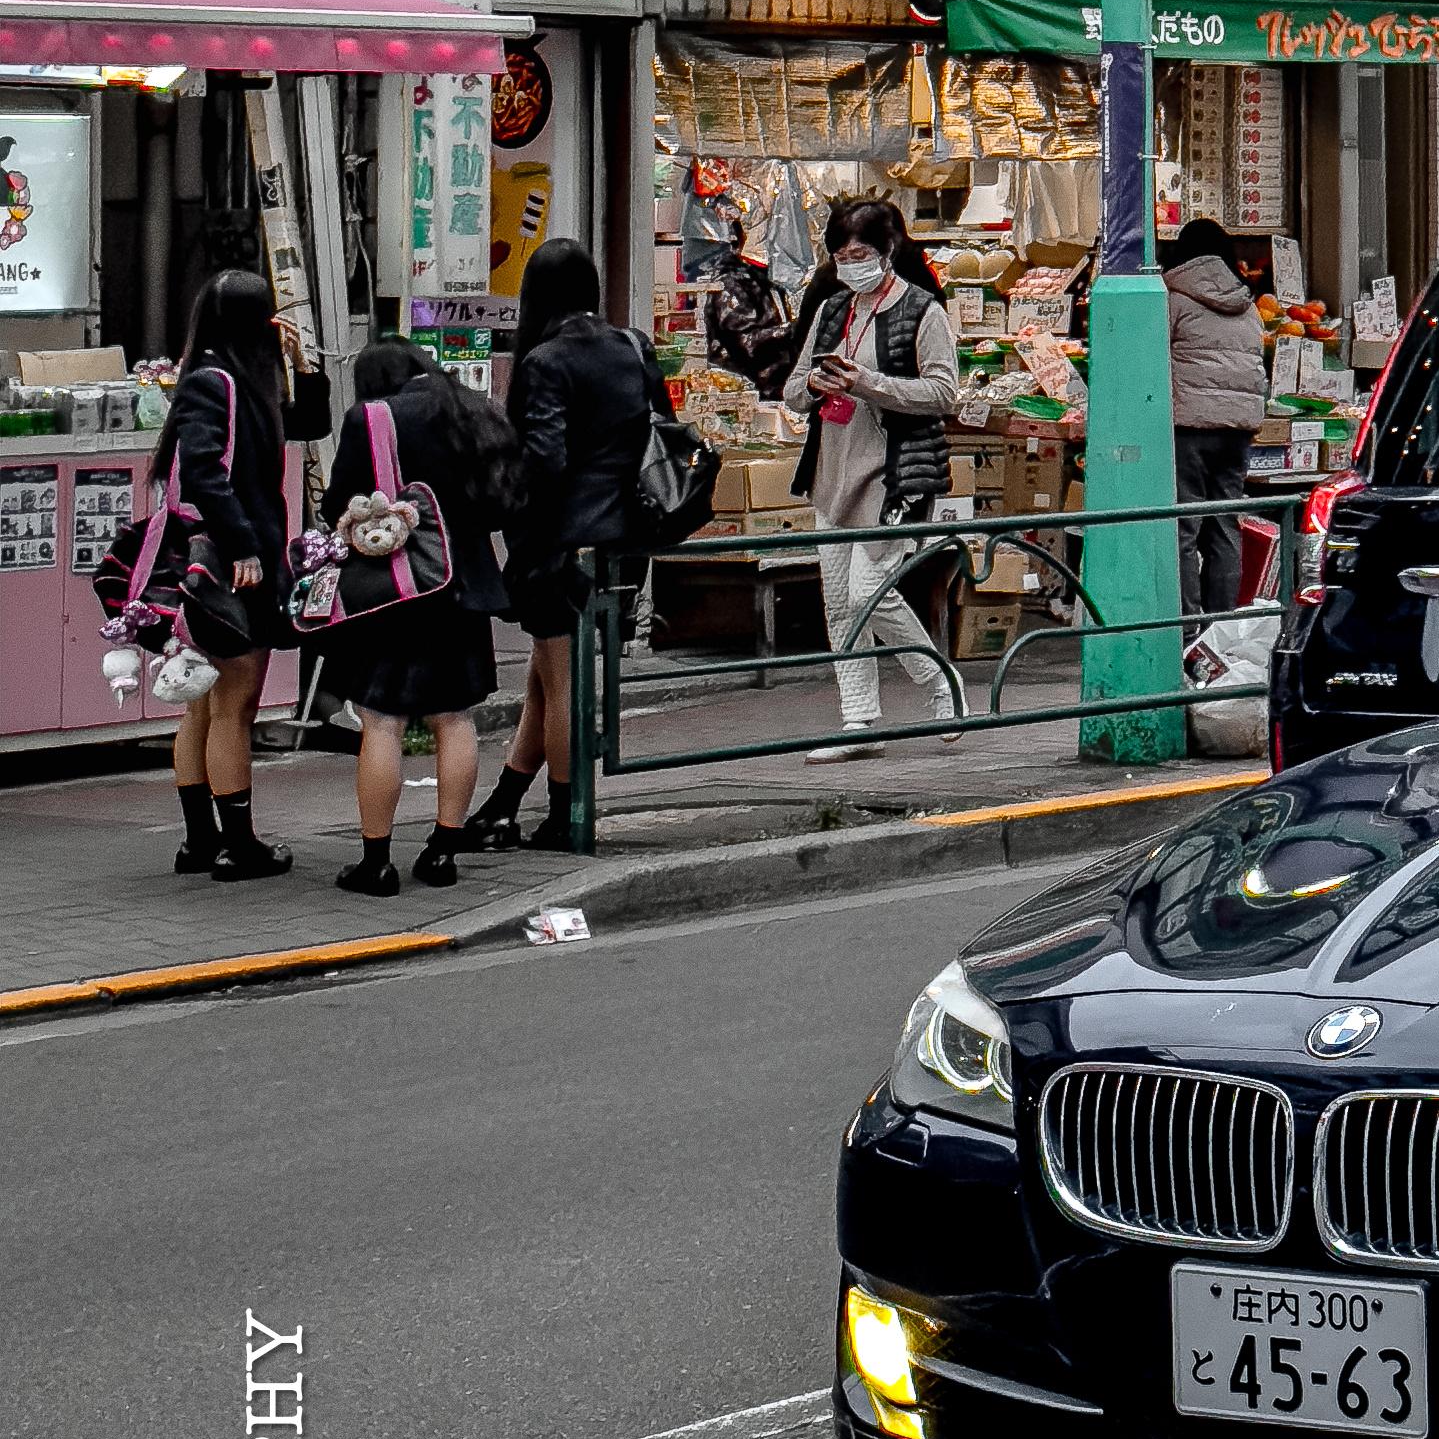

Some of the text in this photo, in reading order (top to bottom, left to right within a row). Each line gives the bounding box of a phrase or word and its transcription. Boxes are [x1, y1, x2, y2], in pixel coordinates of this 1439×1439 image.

[449, 96, 485, 237] 不動産
[1232, 1283, 1369, 1333] 庄内 300
[1191, 1334, 1413, 1424] と 45-63
